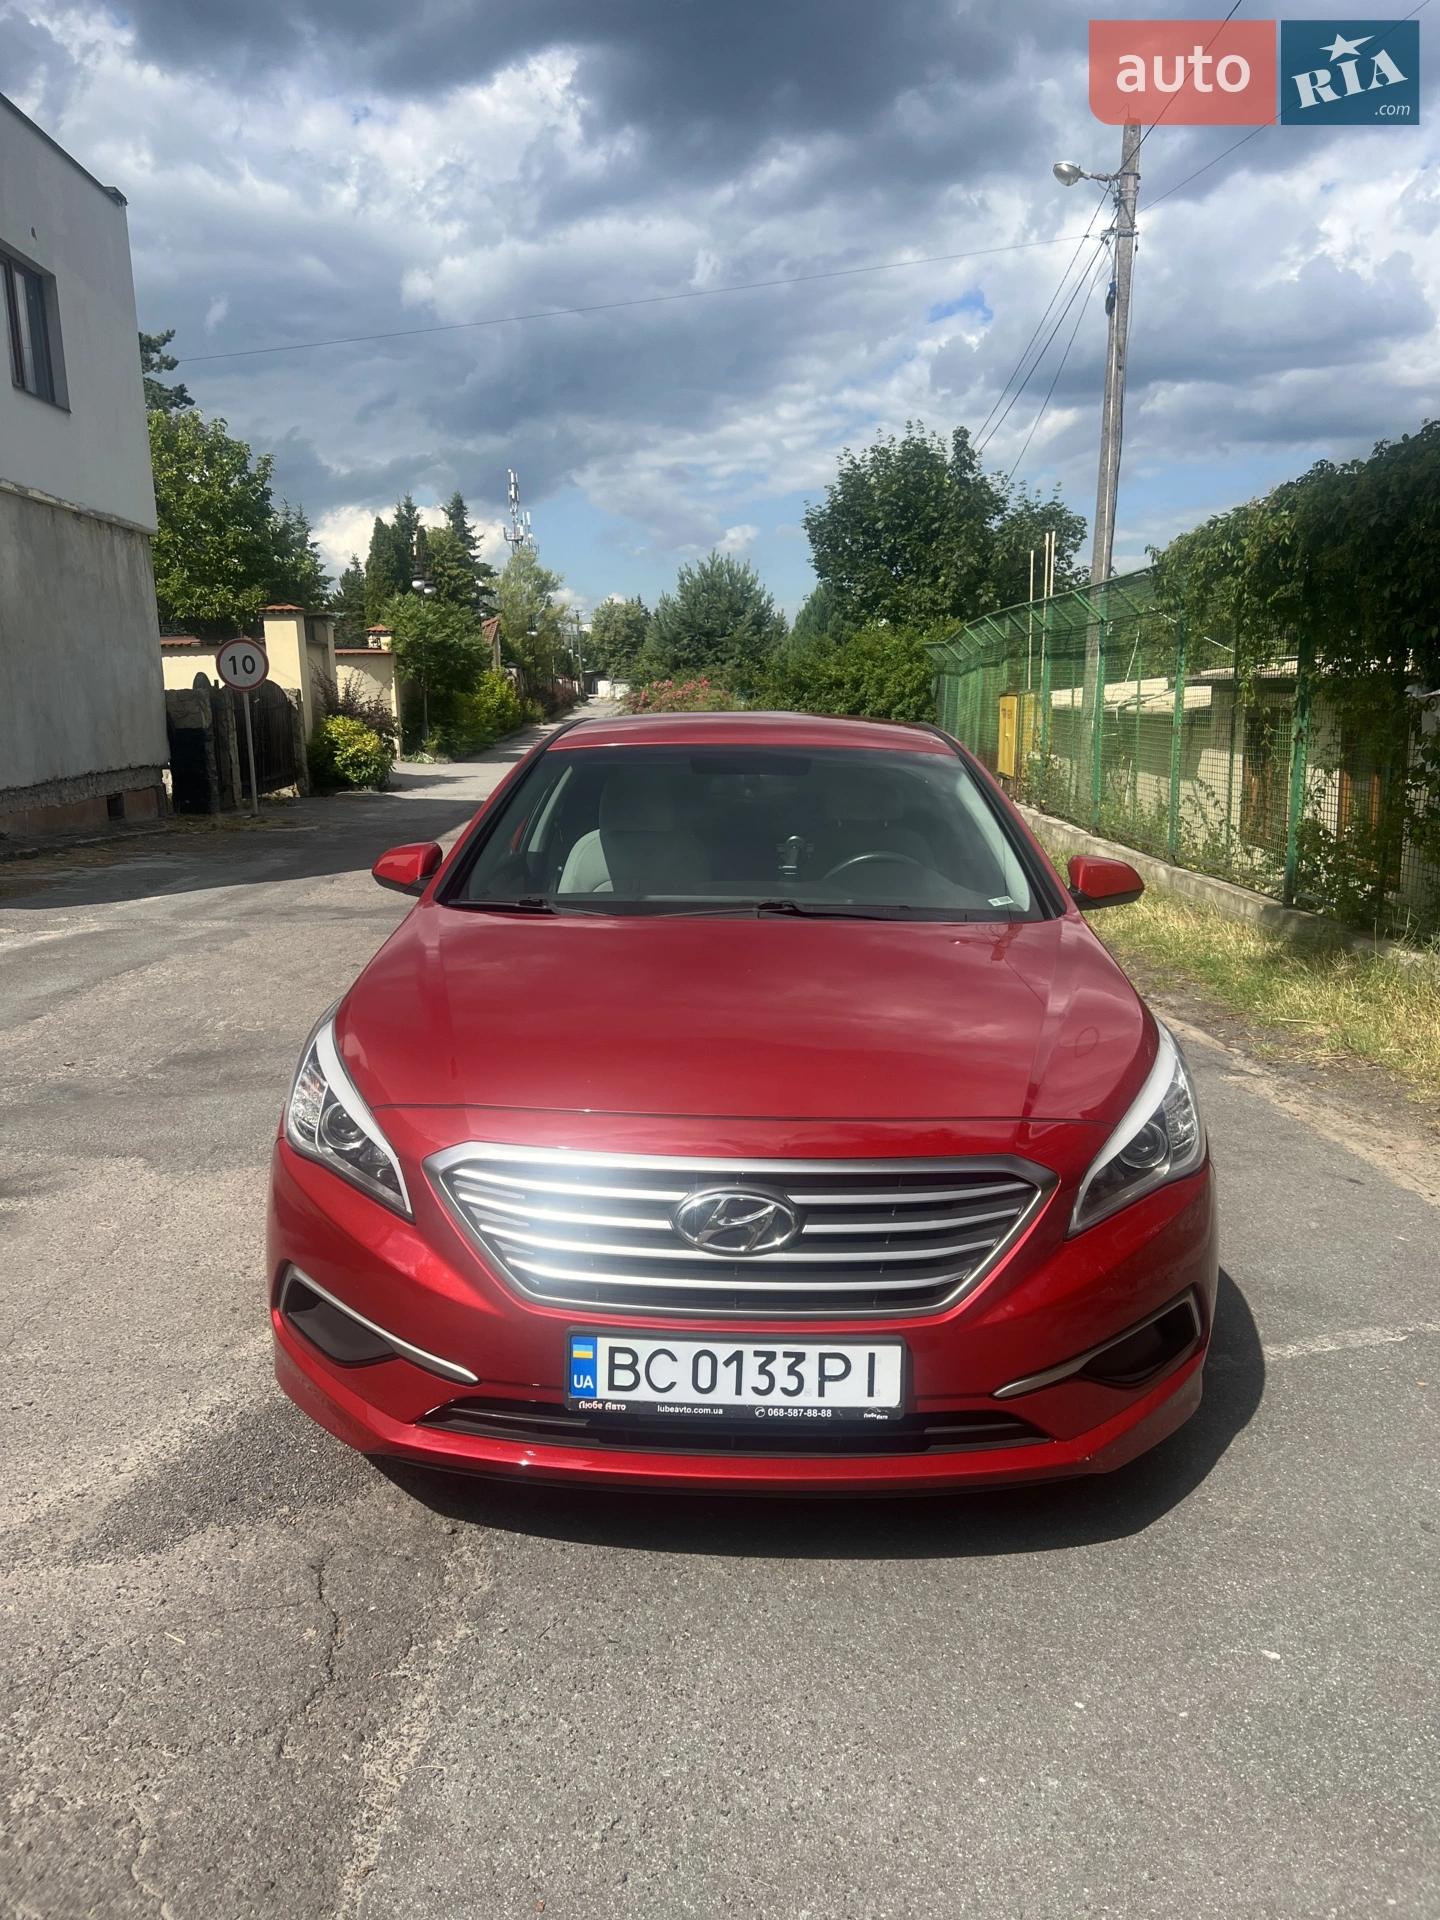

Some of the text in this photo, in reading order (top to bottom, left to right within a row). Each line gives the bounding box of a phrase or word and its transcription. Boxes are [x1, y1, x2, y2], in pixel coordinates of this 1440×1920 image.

[228, 655, 256, 676] 10
[573, 1374, 594, 1389] UA
[605, 1401, 627, 1411] Авто
[657, 1404, 724, 1415] lubeavto.com.ua
[767, 1408, 832, 1418] 068-587-88-88
